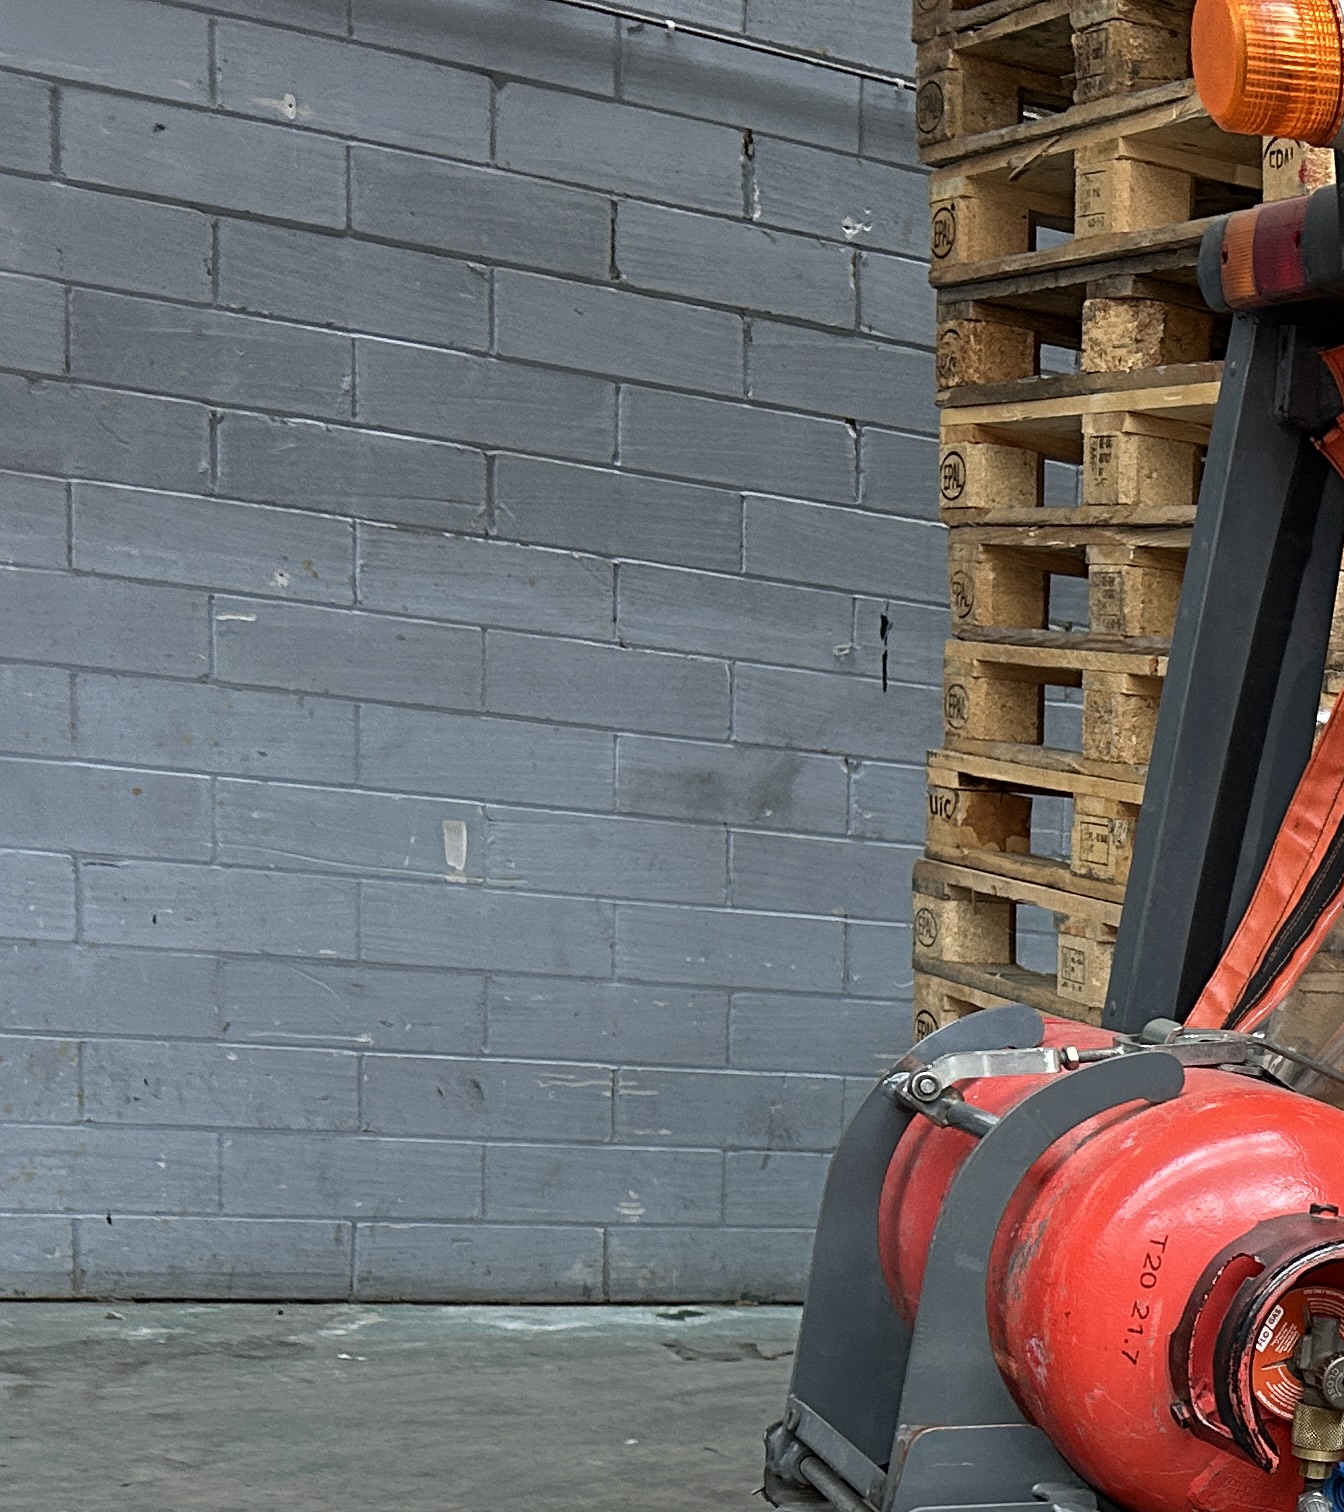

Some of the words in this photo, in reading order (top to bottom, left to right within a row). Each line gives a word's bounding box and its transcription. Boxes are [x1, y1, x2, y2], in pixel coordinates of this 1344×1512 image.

[1139, 1234, 1169, 1289] T20
[1121, 1300, 1150, 1366] 21.7
[1268, 1308, 1282, 1325] GAS
[1327, 1367, 1340, 1400] CLOSE
